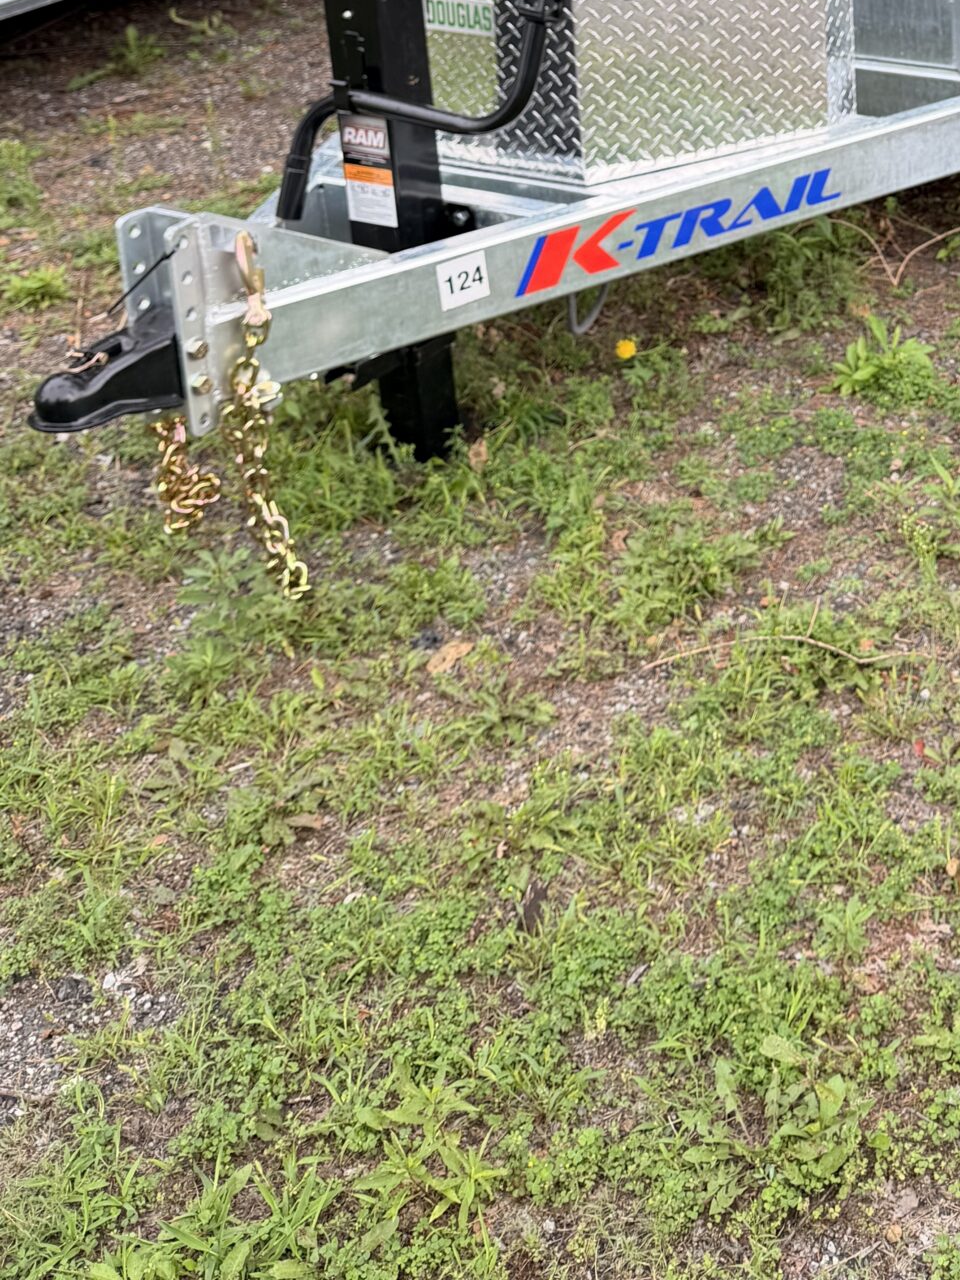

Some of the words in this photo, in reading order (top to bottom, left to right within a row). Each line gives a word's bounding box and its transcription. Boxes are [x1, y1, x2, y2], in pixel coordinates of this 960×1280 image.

[426, 0, 492, 32] DOUGLAS
[343, 126, 385, 149] RAM
[514, 168, 842, 298] K-TRAIL
[445, 265, 483, 294] 124
